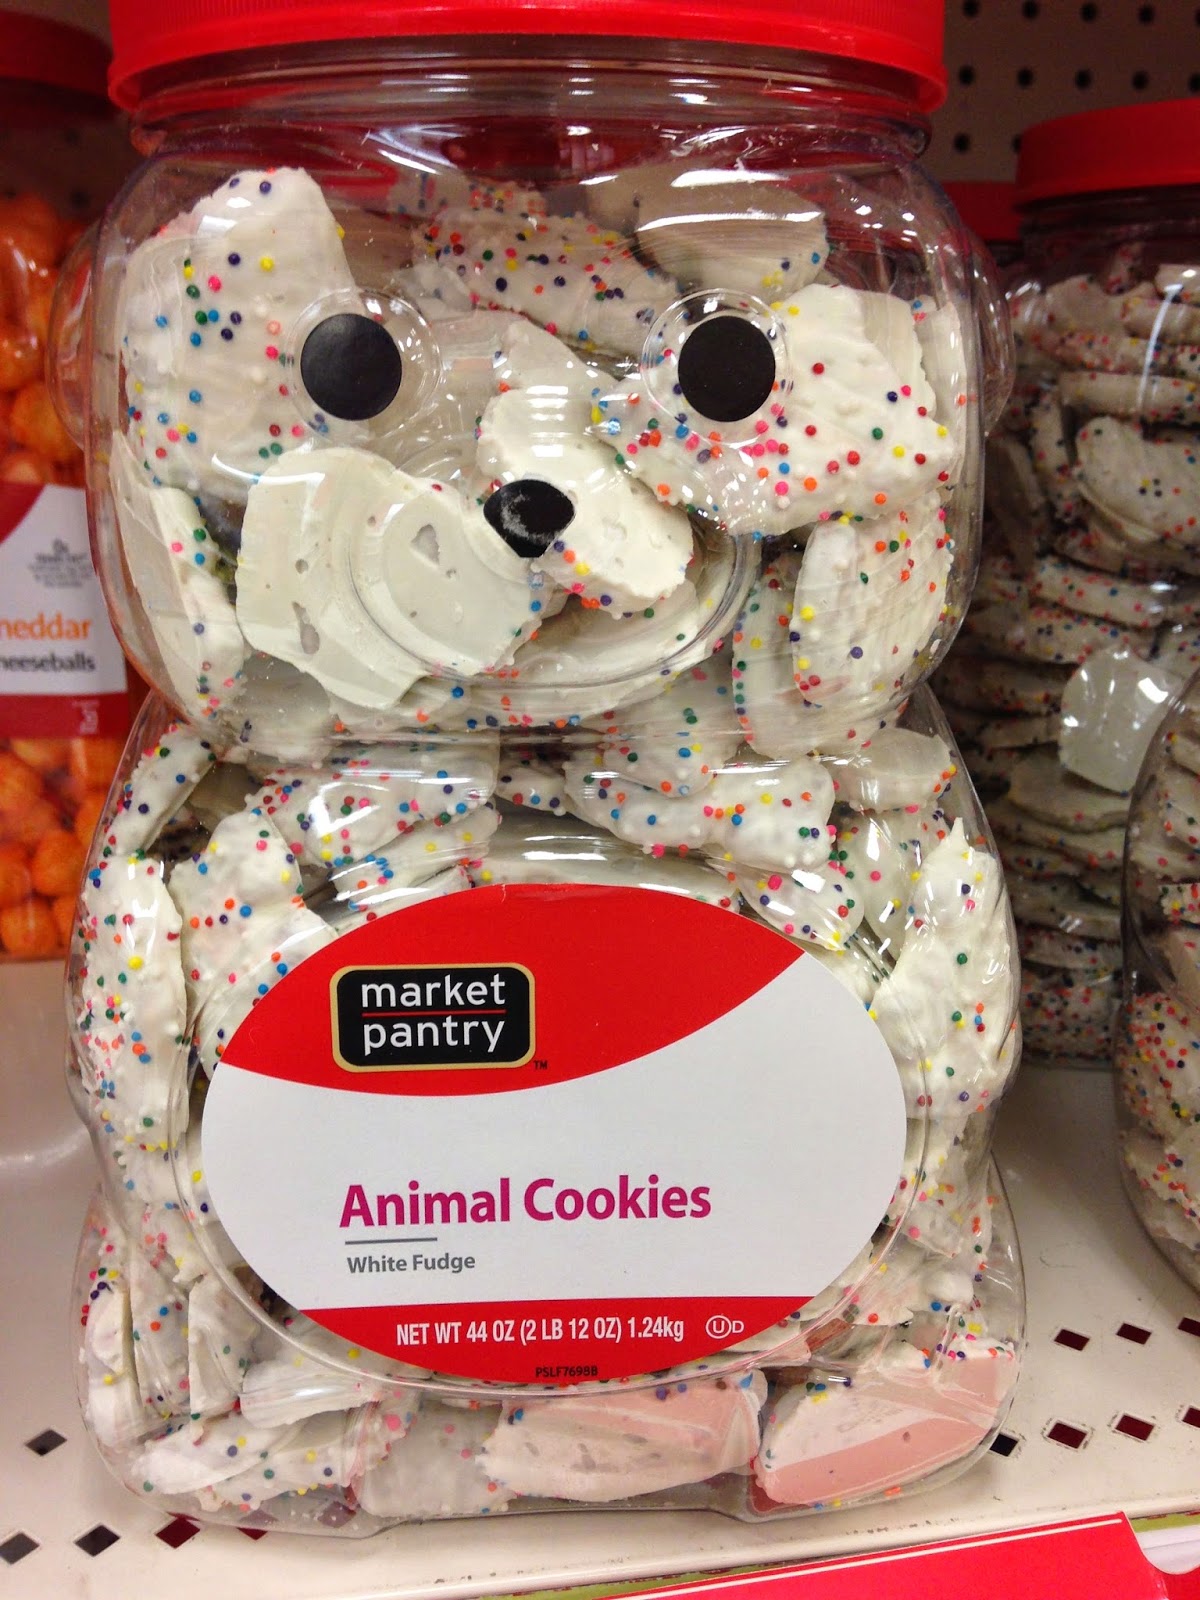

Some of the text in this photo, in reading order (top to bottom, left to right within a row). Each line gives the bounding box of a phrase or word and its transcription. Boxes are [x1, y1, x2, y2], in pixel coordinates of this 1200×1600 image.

[361, 973, 506, 1008] market
[363, 1015, 505, 1056] pantry
[534, 1060, 548, 1070] TM
[339, 1174, 711, 1228] Animal Cookies
[347, 1253, 475, 1274] White Fudge
[397, 1316, 684, 1346] NET WT 44 OZ (2 LB 12 OZ) 1.24kg
